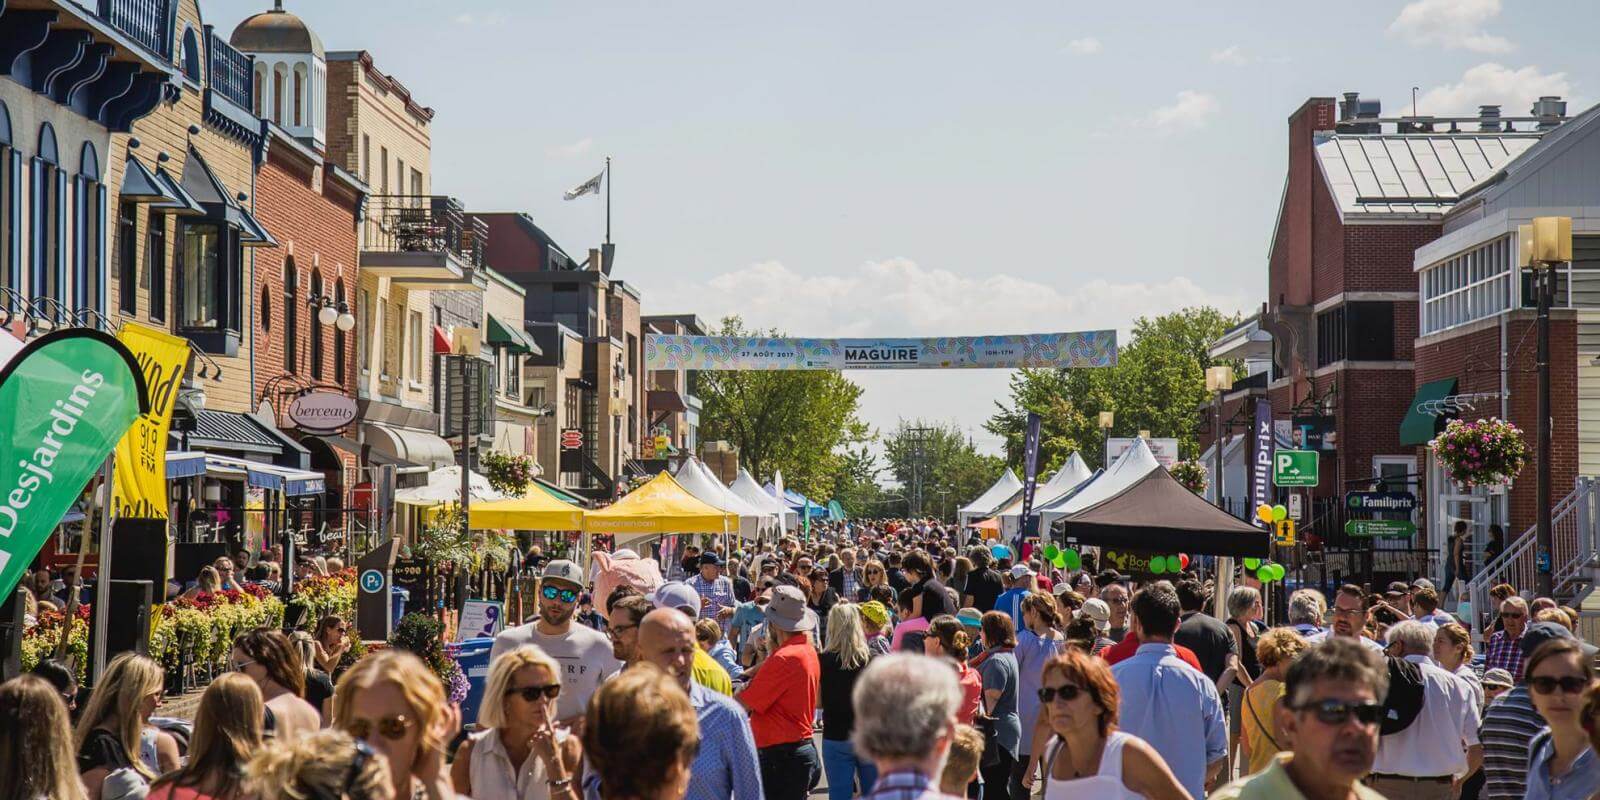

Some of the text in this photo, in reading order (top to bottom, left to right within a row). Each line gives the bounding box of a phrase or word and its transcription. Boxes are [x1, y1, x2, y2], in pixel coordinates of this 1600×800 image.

[845, 349, 918, 361] MAGUIRE
[0, 368, 105, 538] Desjardins
[141, 456, 156, 475] FM
[1277, 454, 1293, 474] P
[1252, 420, 1273, 528] Fmiliprix
[1362, 495, 1412, 509] Familiprix
